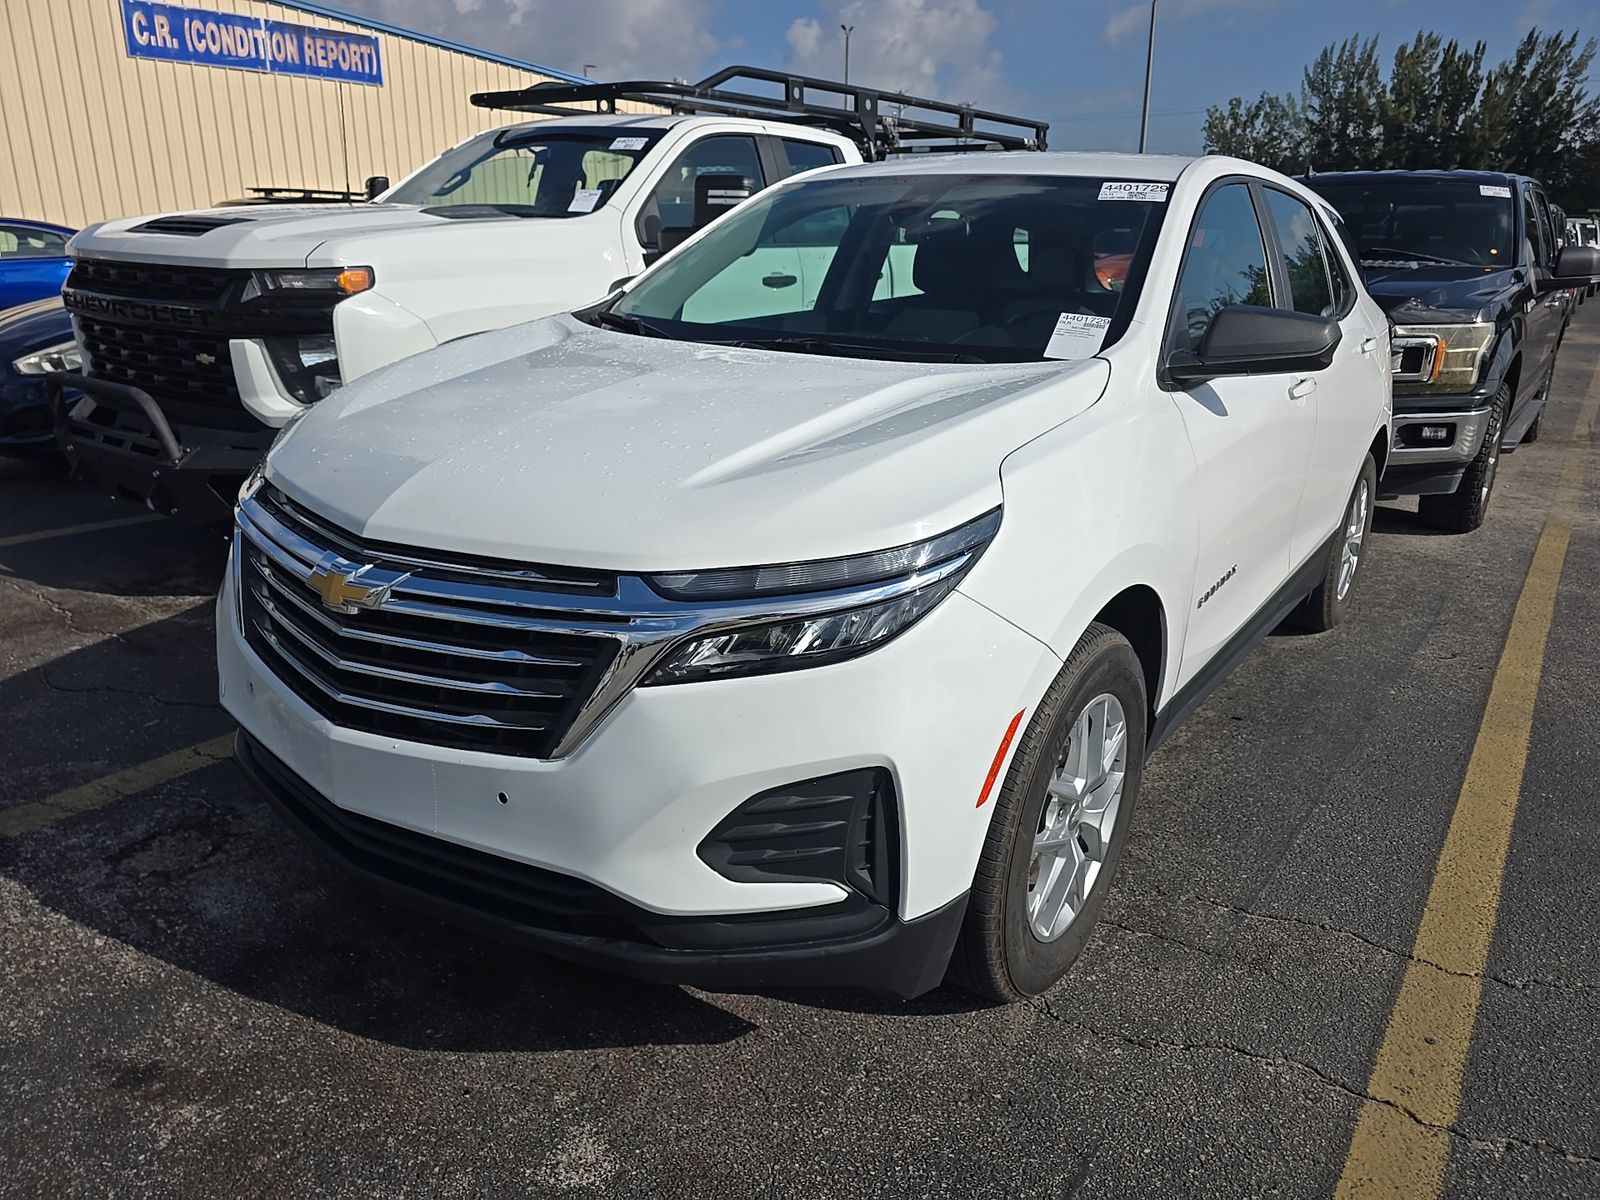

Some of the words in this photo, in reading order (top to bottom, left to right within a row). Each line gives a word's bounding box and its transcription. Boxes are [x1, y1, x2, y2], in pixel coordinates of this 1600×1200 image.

[133, 10, 178, 49] C.R.
[186, 18, 300, 64] (CONDITION
[304, 37, 377, 76] REPORT)
[1104, 184, 1169, 193] 4401729
[63, 291, 214, 326] CHEVROLET
[1062, 315, 1110, 325] 4401729
